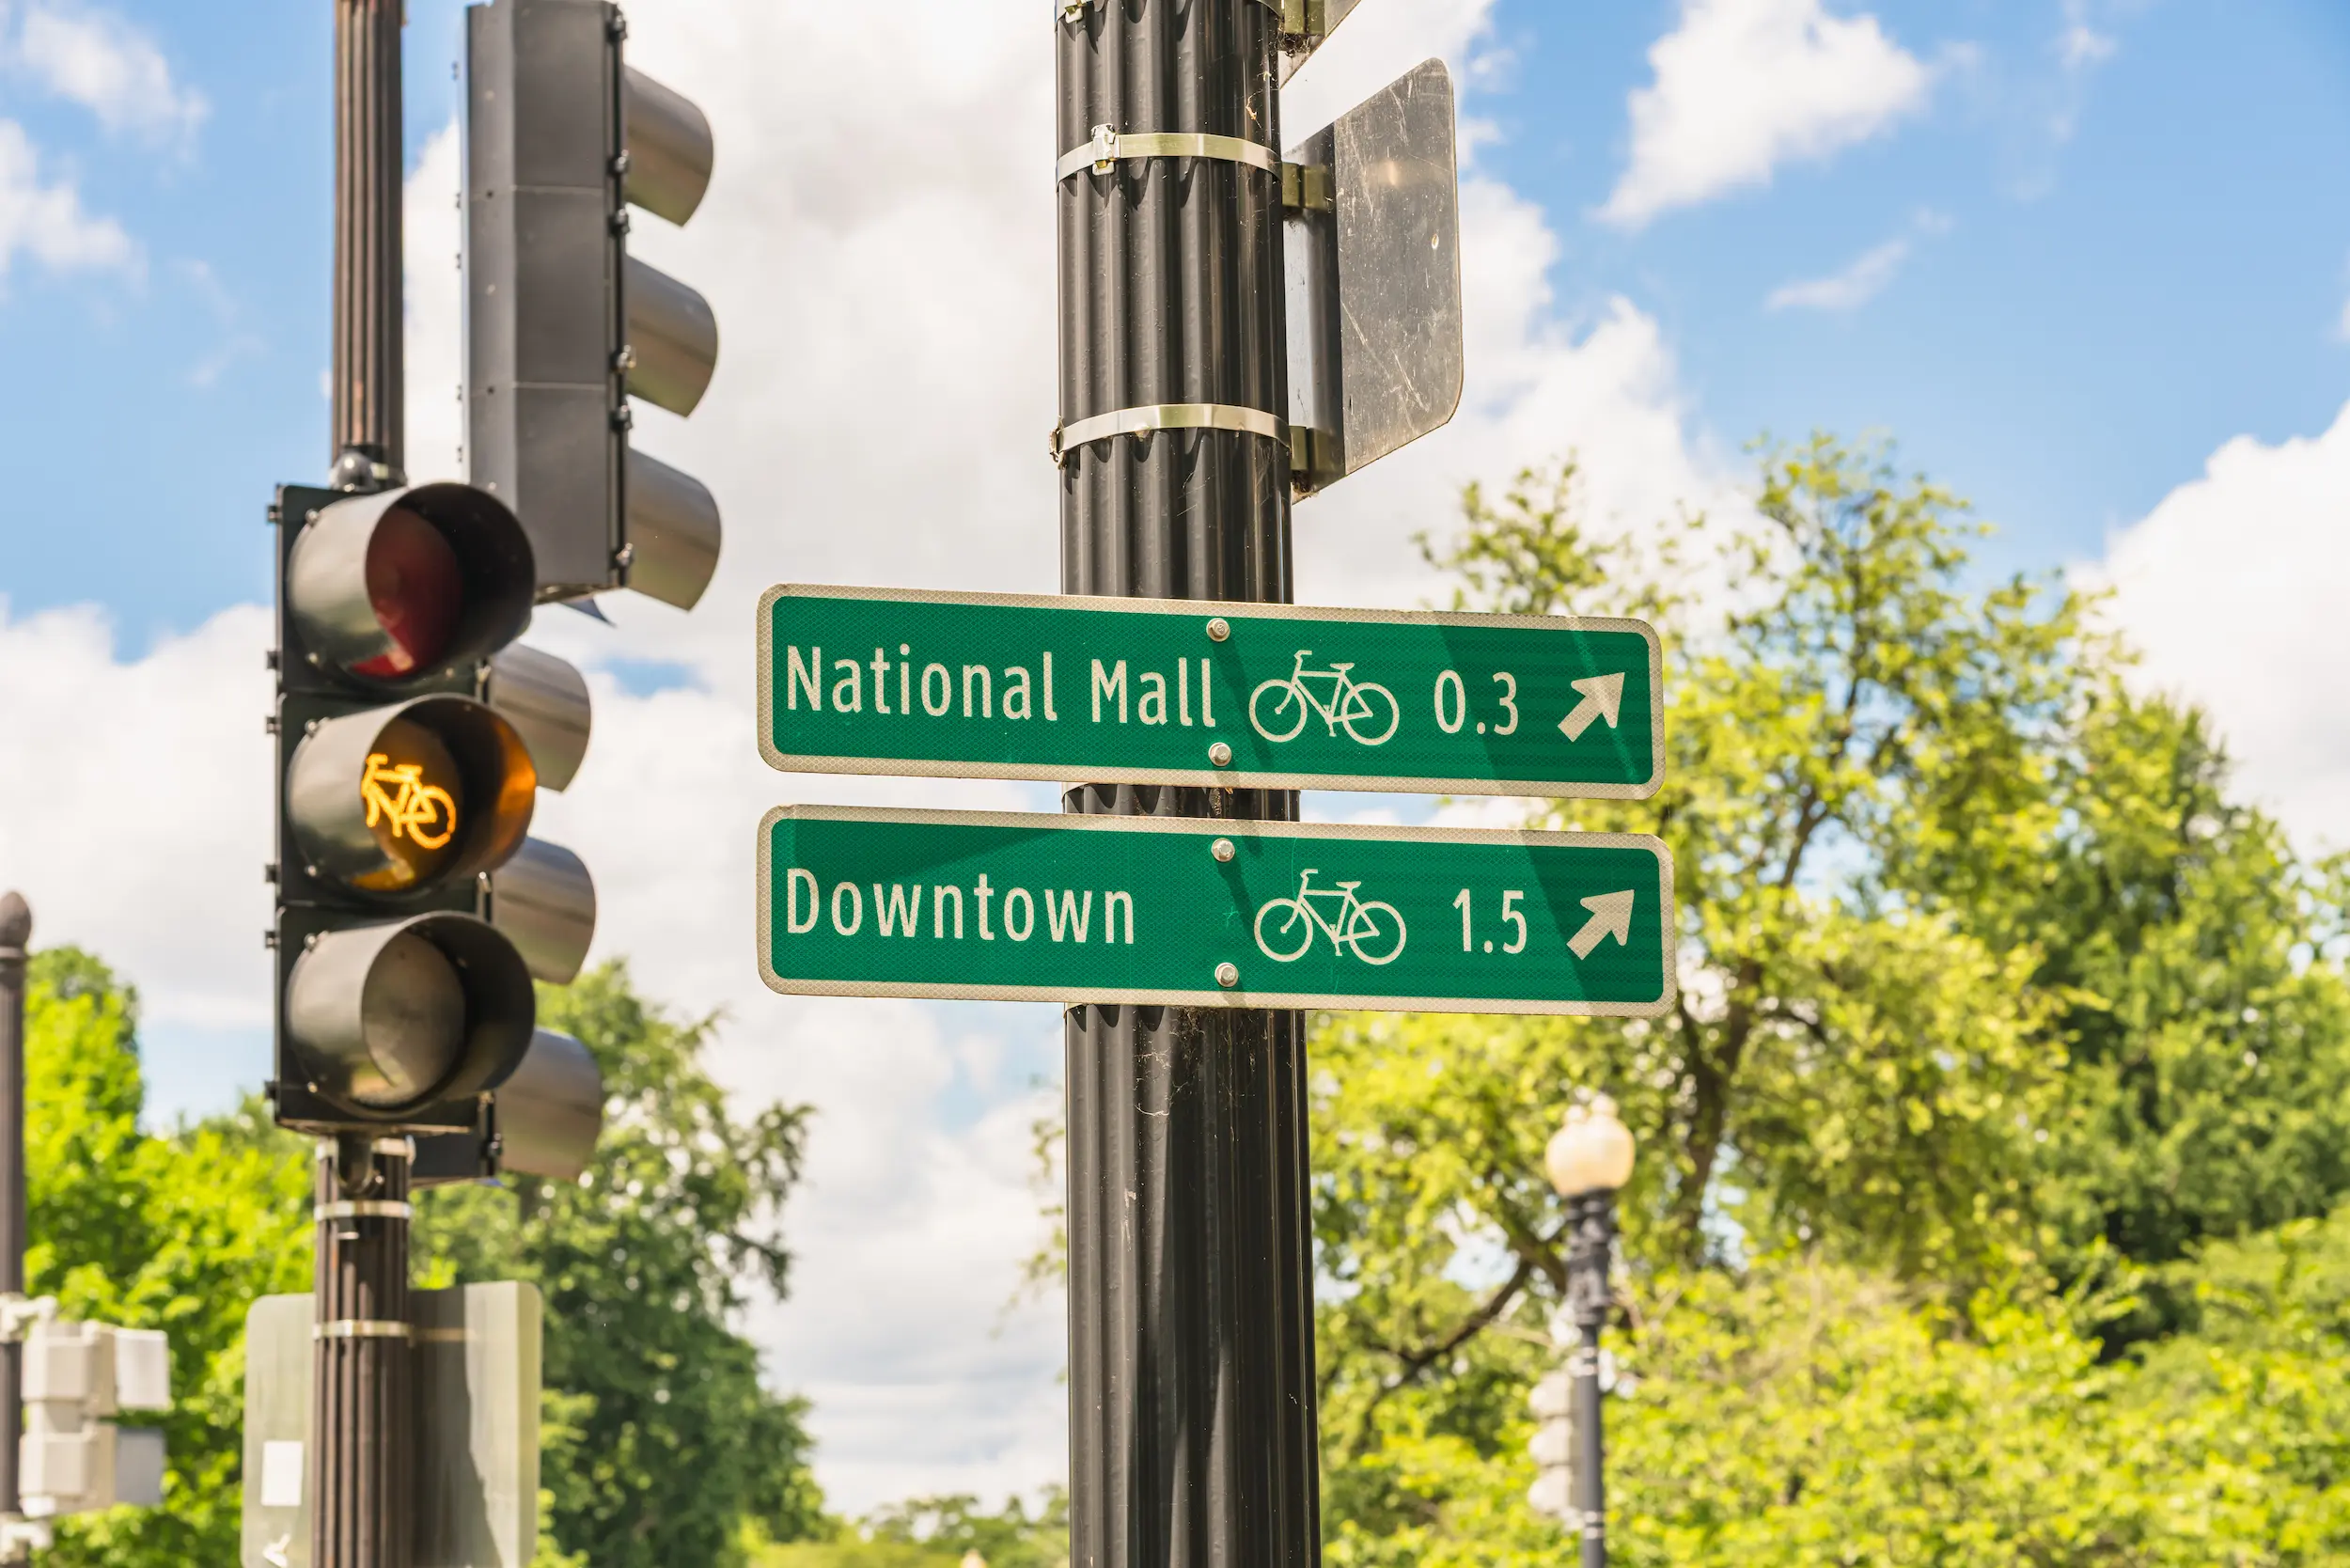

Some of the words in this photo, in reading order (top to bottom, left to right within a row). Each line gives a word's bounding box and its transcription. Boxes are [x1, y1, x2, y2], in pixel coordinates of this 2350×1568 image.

[787, 644, 1058, 721] National
[1090, 657, 1216, 728] Mall
[1434, 669, 1518, 736] 0.3
[787, 868, 1134, 945] Downtown
[1452, 888, 1528, 954] 1.5
